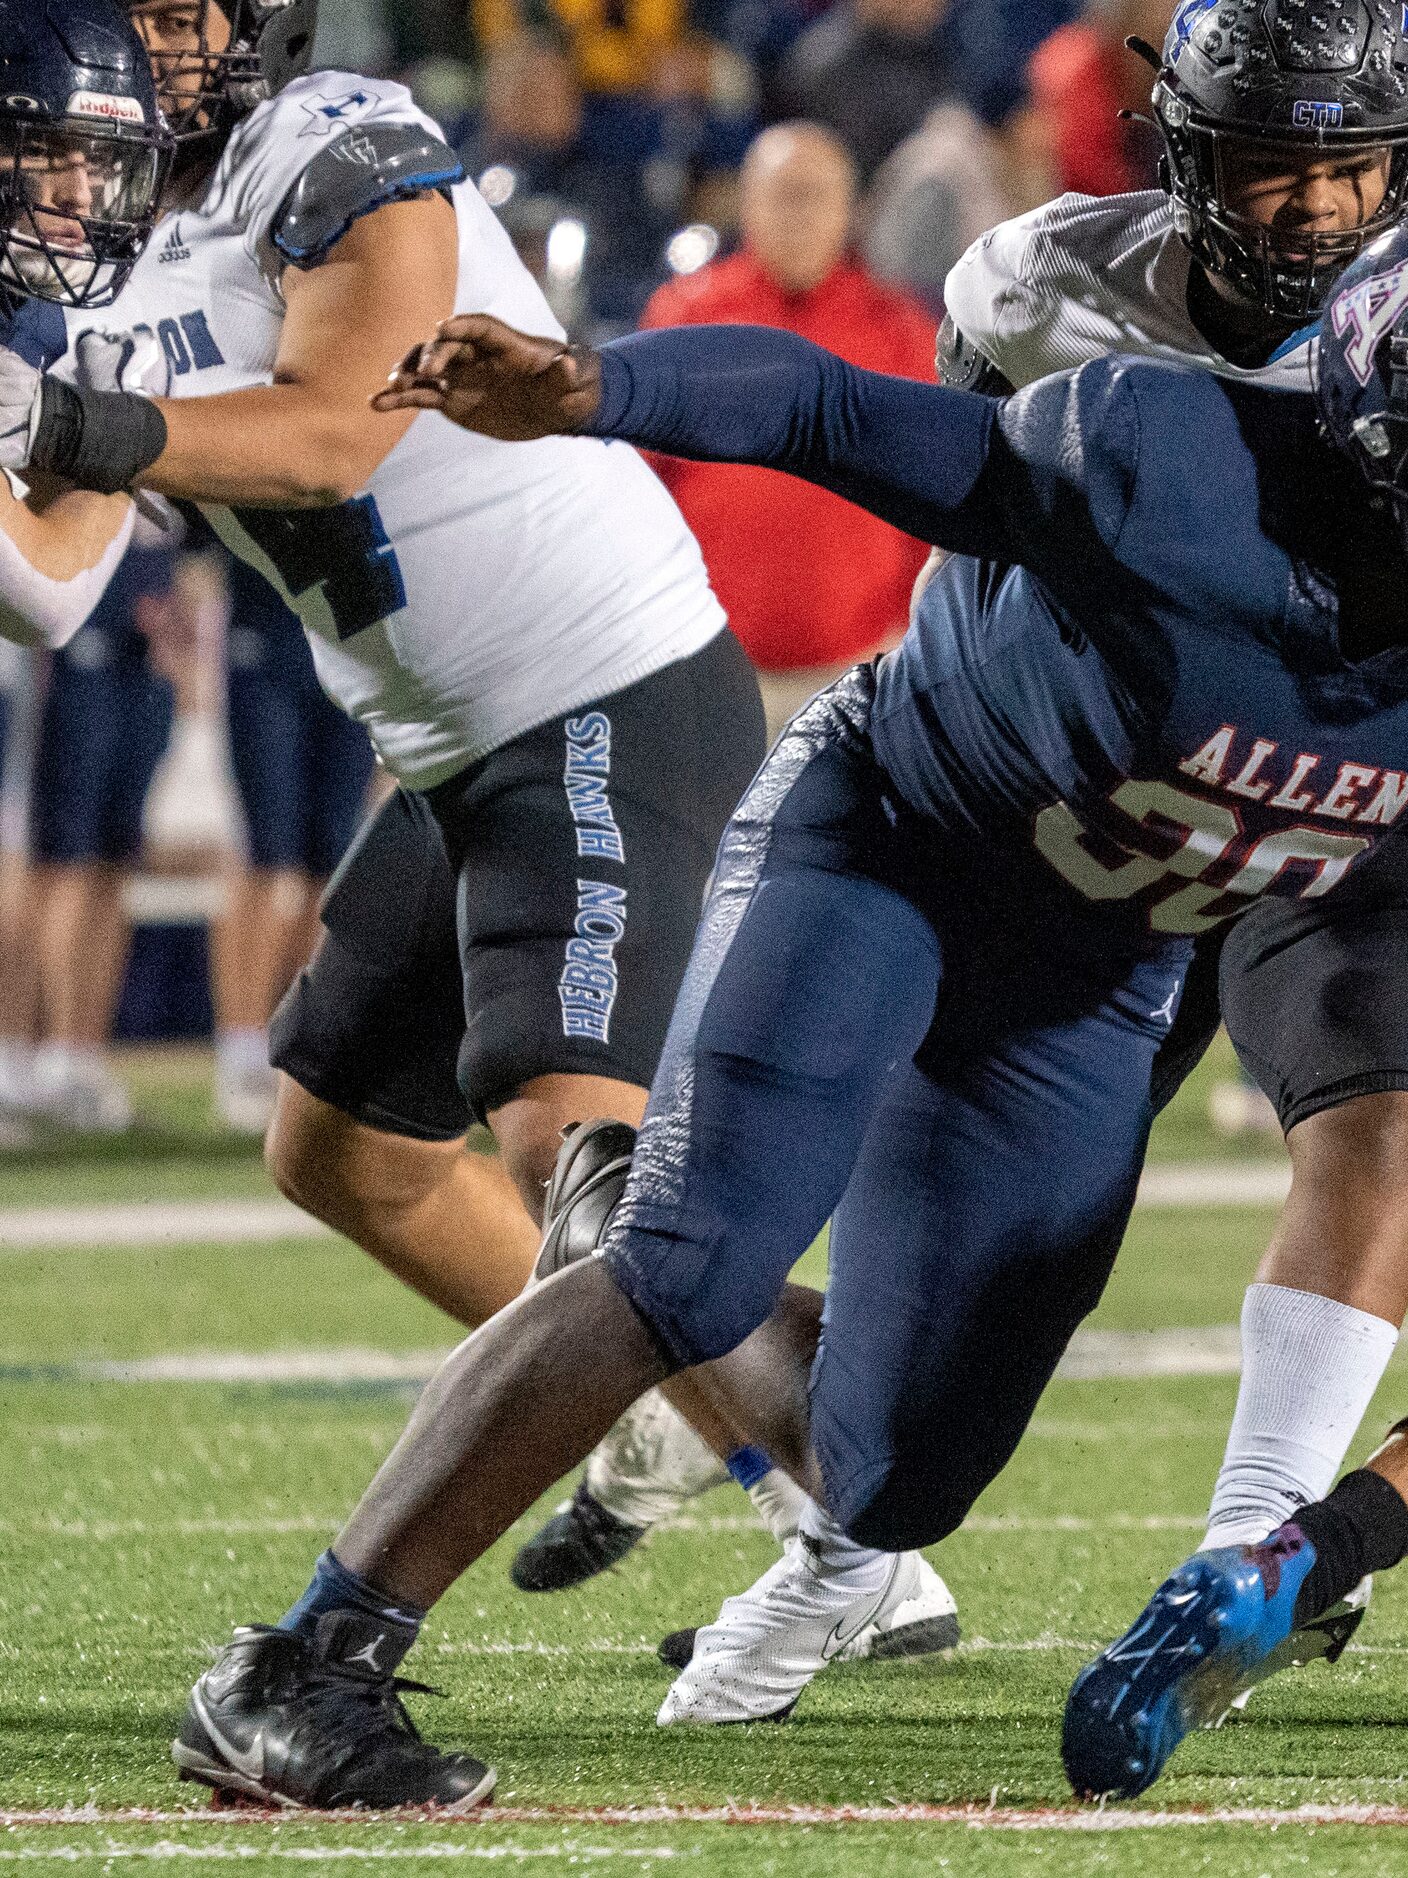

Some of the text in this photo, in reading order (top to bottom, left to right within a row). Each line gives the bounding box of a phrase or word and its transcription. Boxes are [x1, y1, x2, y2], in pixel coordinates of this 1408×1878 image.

[1292, 100, 1344, 128] CTD
[159, 247, 191, 263] adidas
[557, 711, 628, 1045] HEBRON HAWKS
